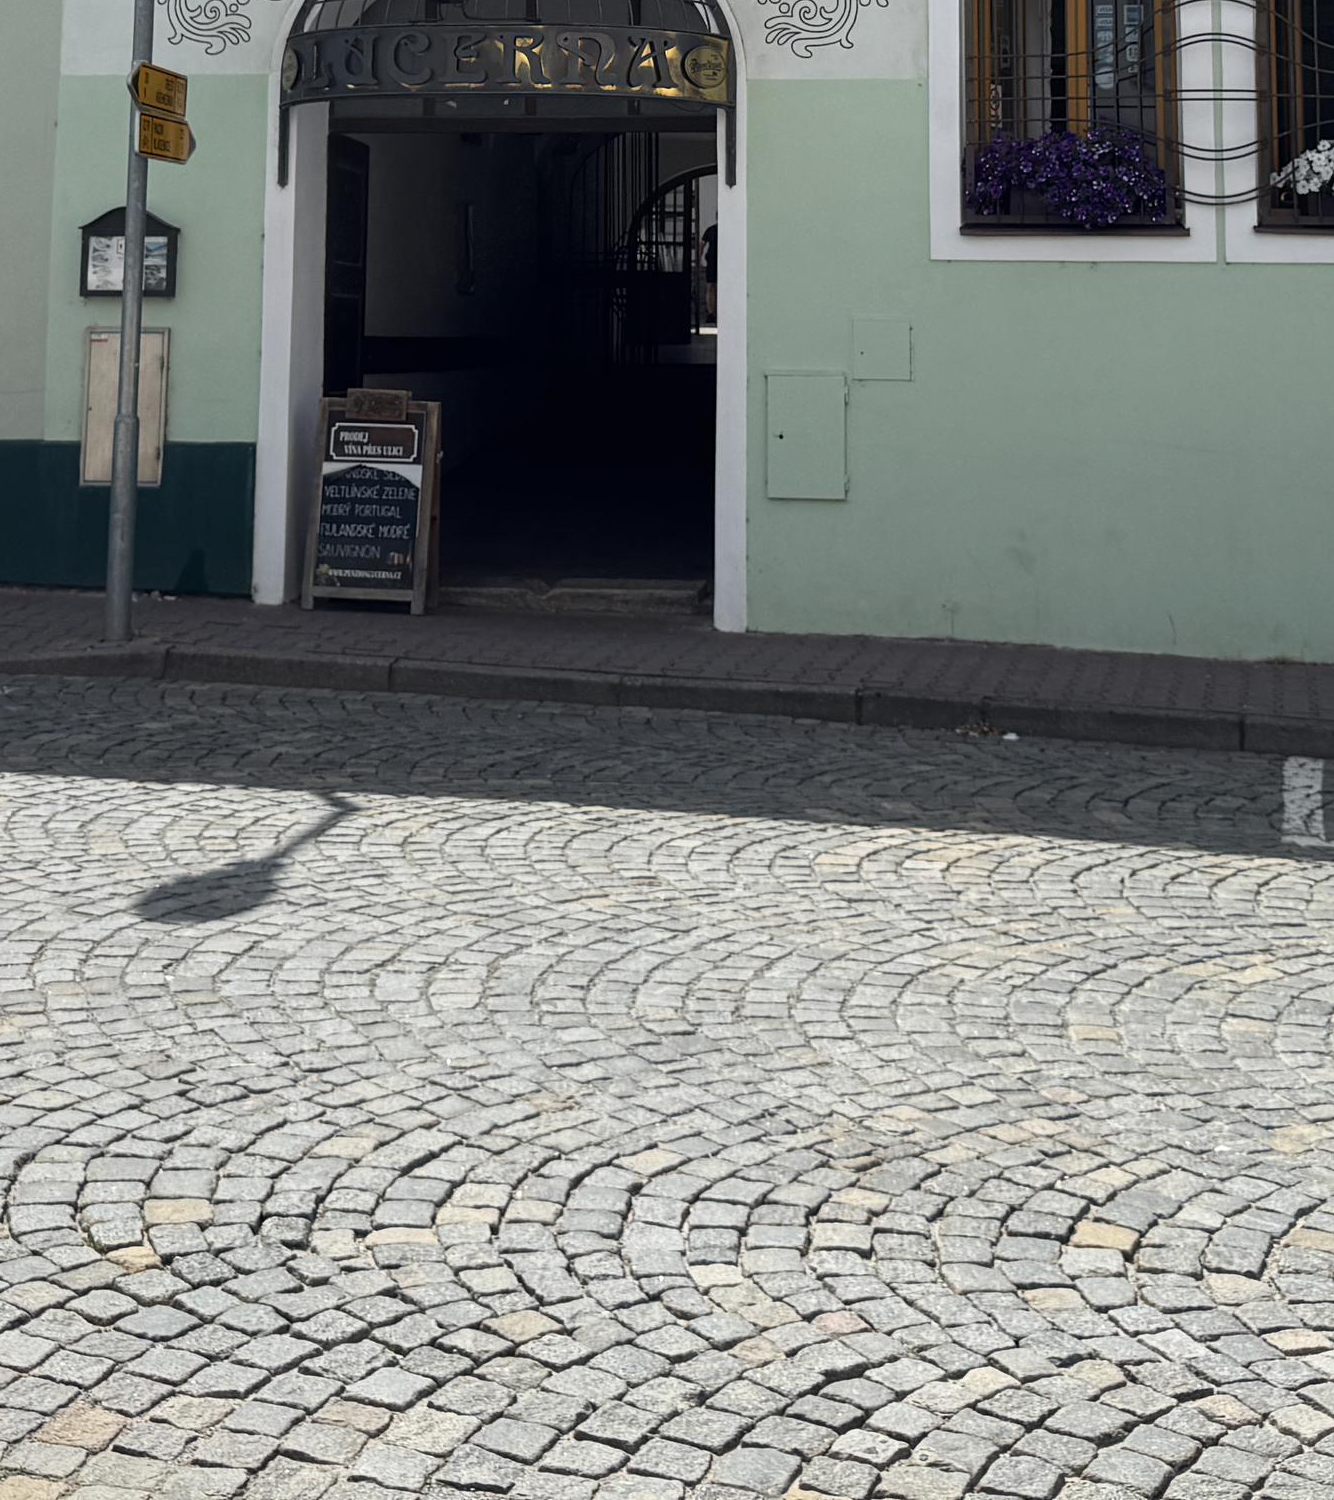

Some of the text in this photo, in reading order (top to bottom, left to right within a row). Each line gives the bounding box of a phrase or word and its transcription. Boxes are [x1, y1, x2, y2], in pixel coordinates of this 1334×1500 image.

[299, 30, 679, 90] LUCERNA
[339, 431, 369, 443] PRODEJ
[324, 483, 380, 499] VELTLÍNSKÉ
[354, 504, 402, 519] PORTUGAL
